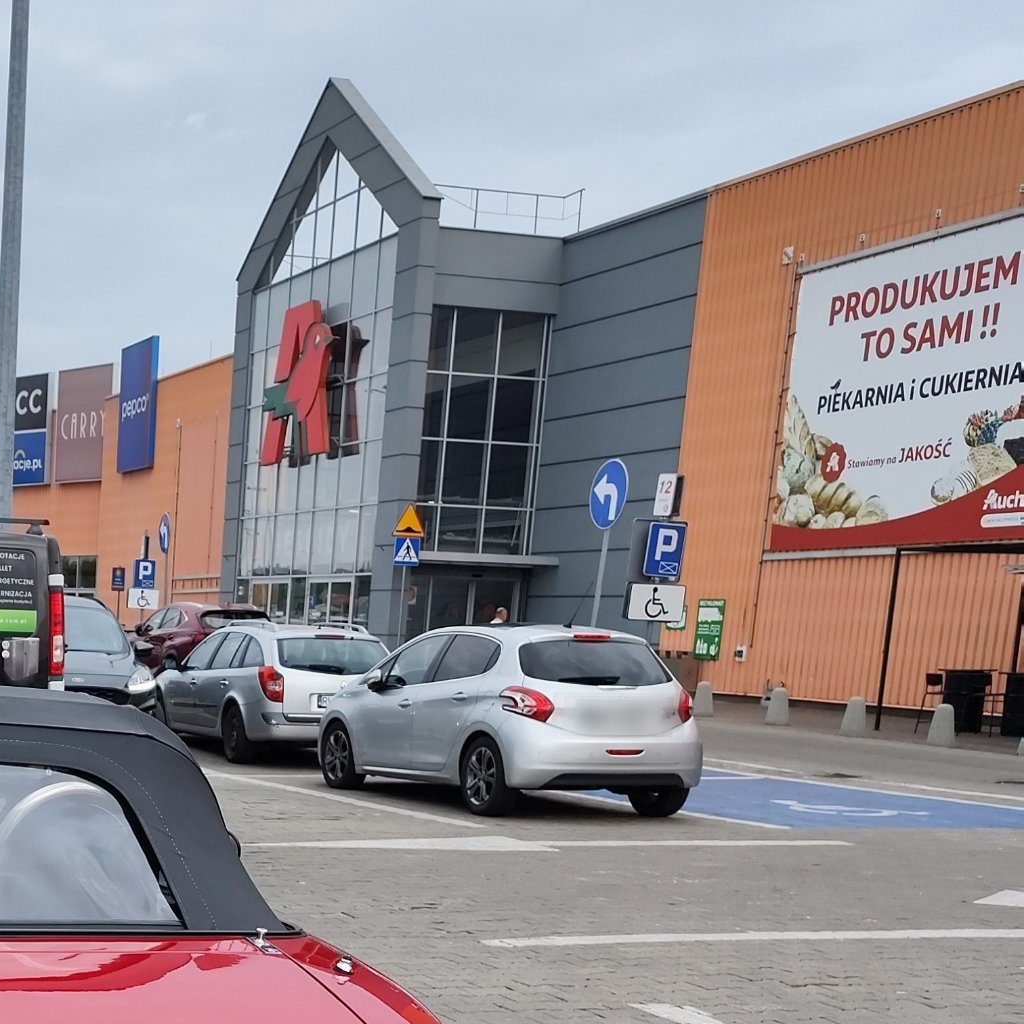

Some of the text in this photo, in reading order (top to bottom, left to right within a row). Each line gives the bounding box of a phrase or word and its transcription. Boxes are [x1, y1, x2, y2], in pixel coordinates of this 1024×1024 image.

[829, 251, 1021, 326] PRODUKUJEM
[861, 327, 895, 362] TO
[900, 310, 974, 354] SAMI
[817, 362, 1024, 415] PIEKARNIA i CUKIERNIA
[61, 410, 106, 440] CARRY
[121, 396, 147, 422] pepco
[847, 437, 953, 469] Stawiamy na JAKOŚĆ
[659, 480, 673, 495] 12
[654, 528, 679, 561] P
[139, 561, 152, 580] P
